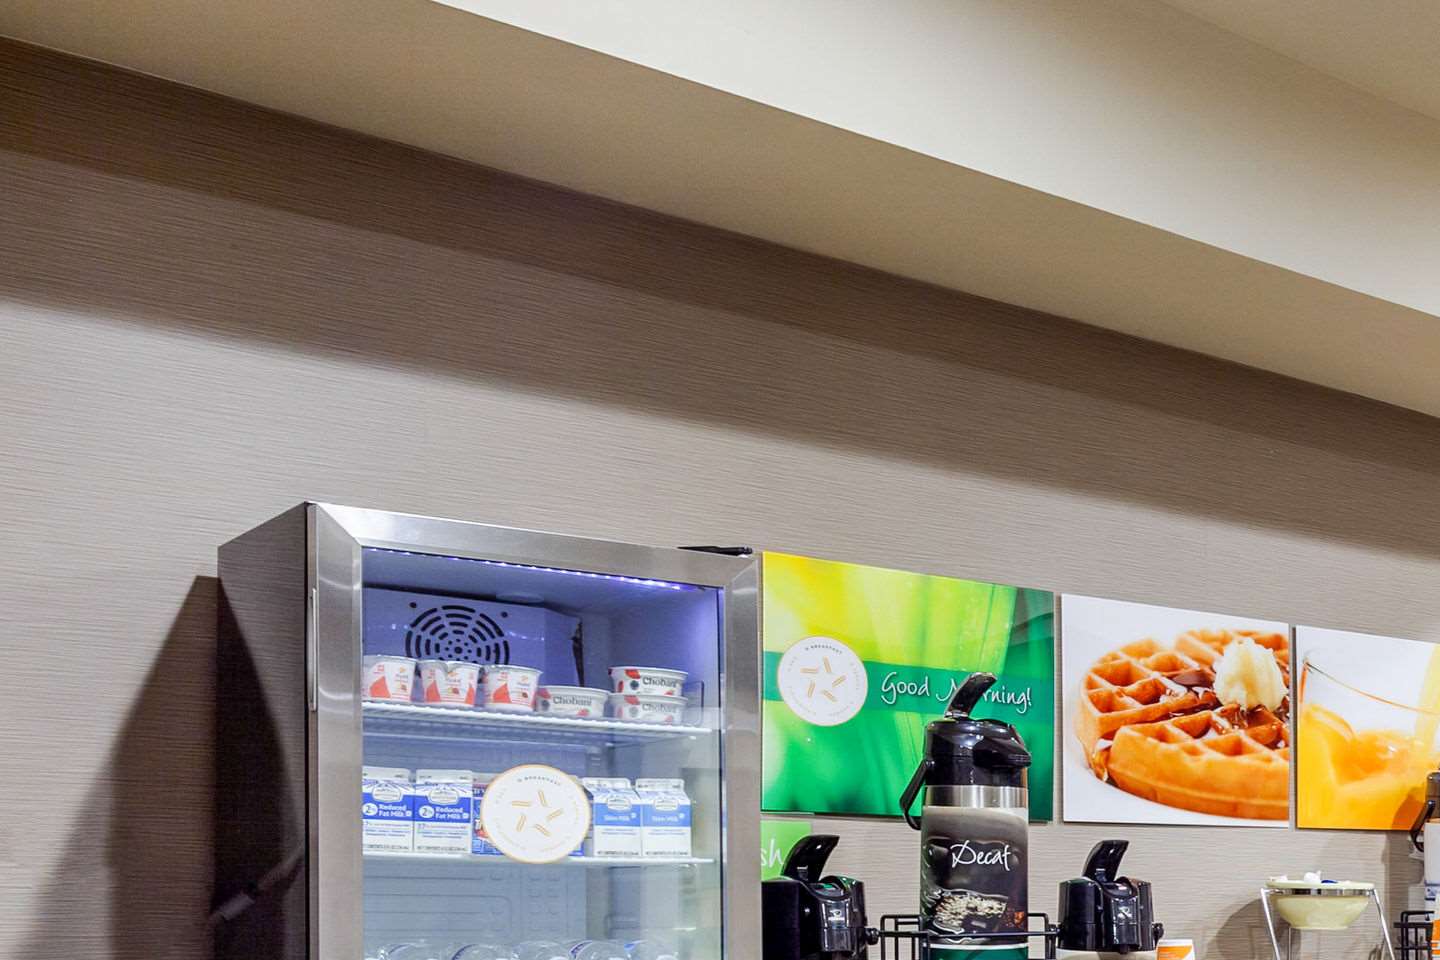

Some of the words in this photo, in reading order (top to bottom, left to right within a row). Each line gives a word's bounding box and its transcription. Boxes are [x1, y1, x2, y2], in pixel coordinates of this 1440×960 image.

[880, 671, 931, 705] Good
[935, 678, 1033, 715] Mrning!
[760, 833, 784, 869] sh
[951, 839, 1012, 871] Decaf
